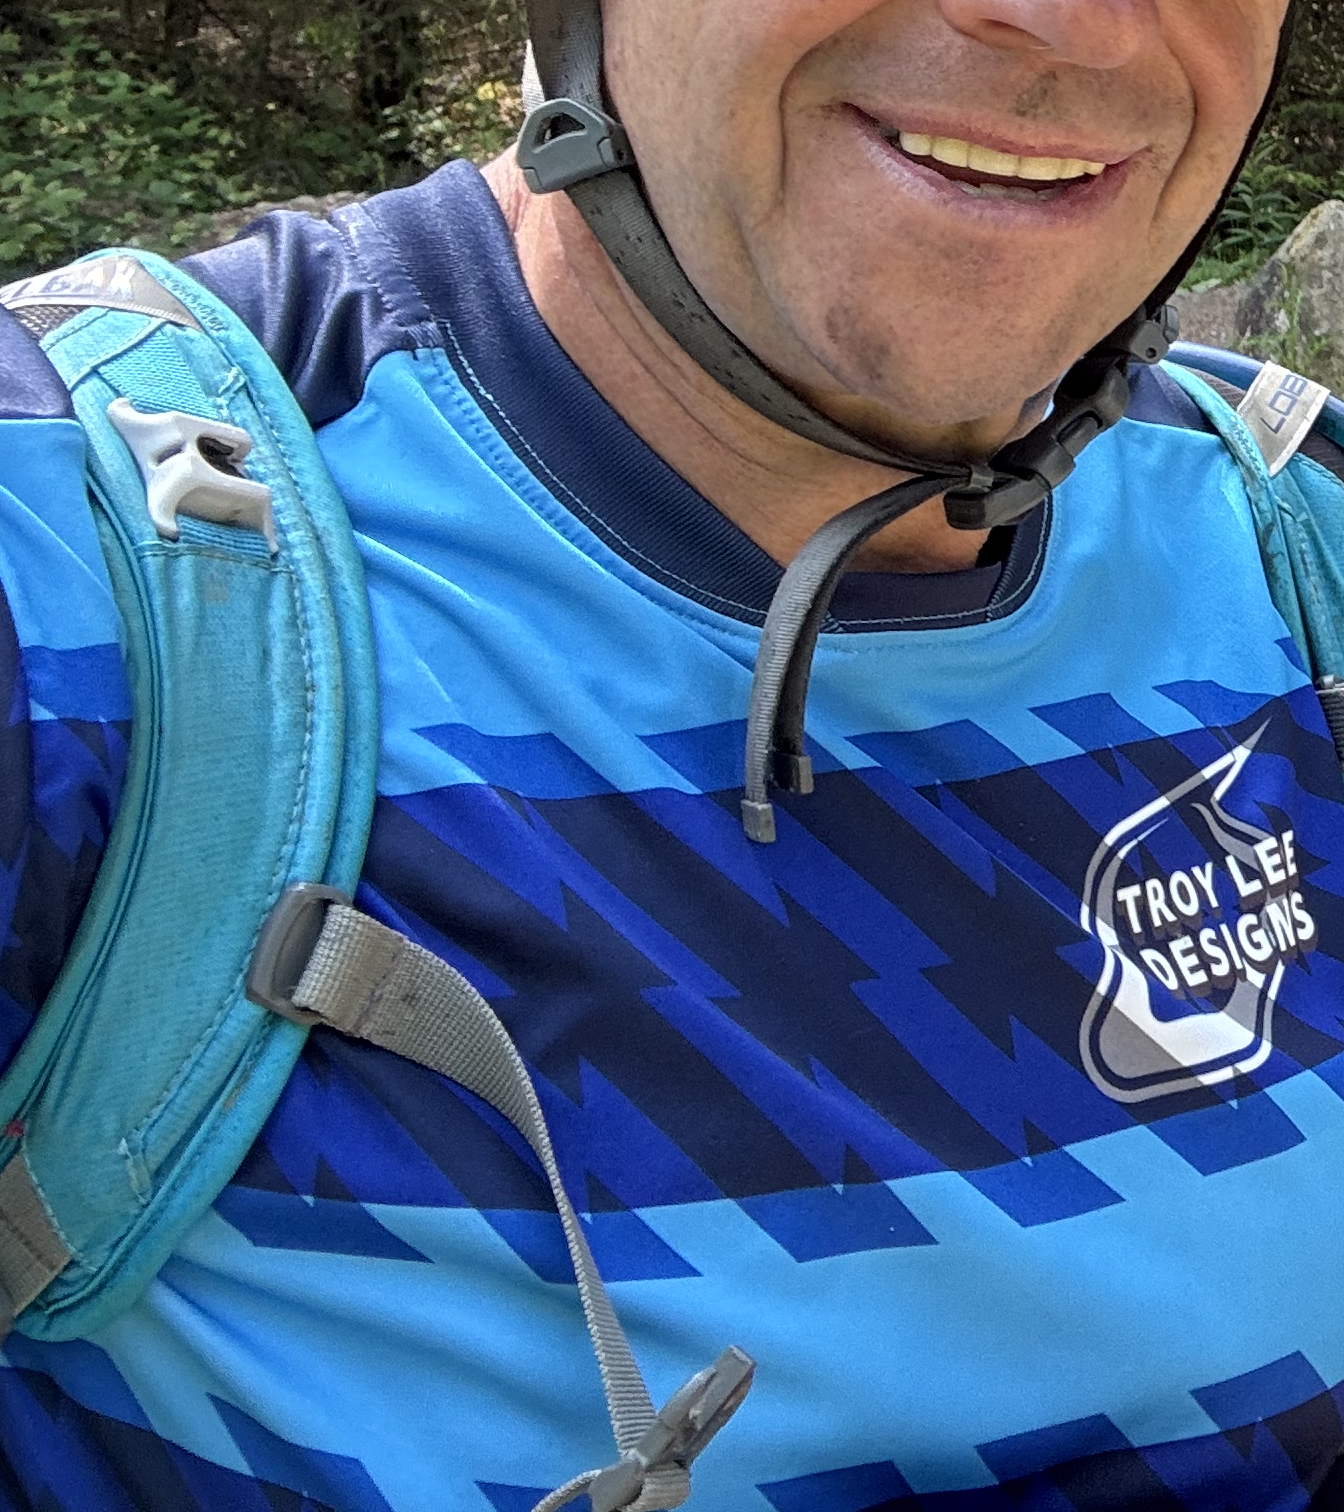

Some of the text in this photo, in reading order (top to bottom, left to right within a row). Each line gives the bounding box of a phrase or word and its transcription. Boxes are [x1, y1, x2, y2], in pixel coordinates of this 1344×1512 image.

[1116, 830, 1299, 935] TROY LEE
[1138, 889, 1316, 992] DESIGNS
